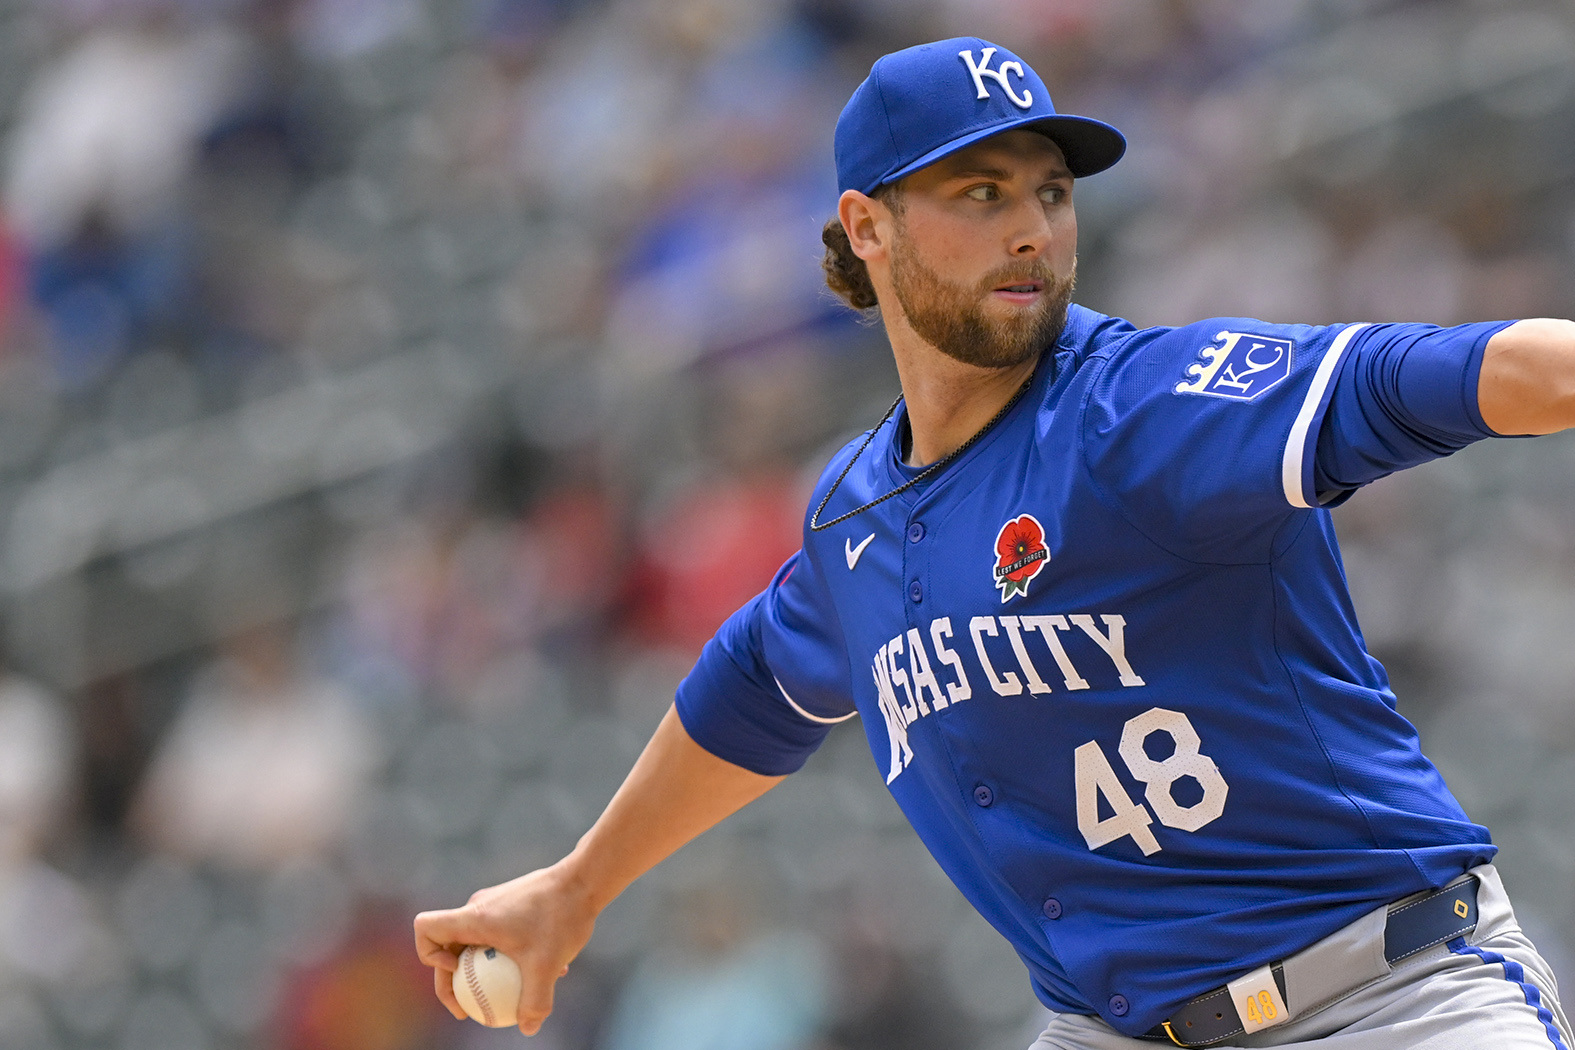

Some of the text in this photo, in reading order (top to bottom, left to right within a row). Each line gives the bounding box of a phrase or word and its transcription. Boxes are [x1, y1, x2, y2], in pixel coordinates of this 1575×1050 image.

[959, 47, 1034, 109] KC
[1213, 343, 1284, 394] KC
[998, 551, 1044, 576] LEST WE FORGET
[871, 614, 1146, 786] NSAS CITY
[1074, 707, 1230, 857] 48
[1247, 990, 1279, 1025] 48
